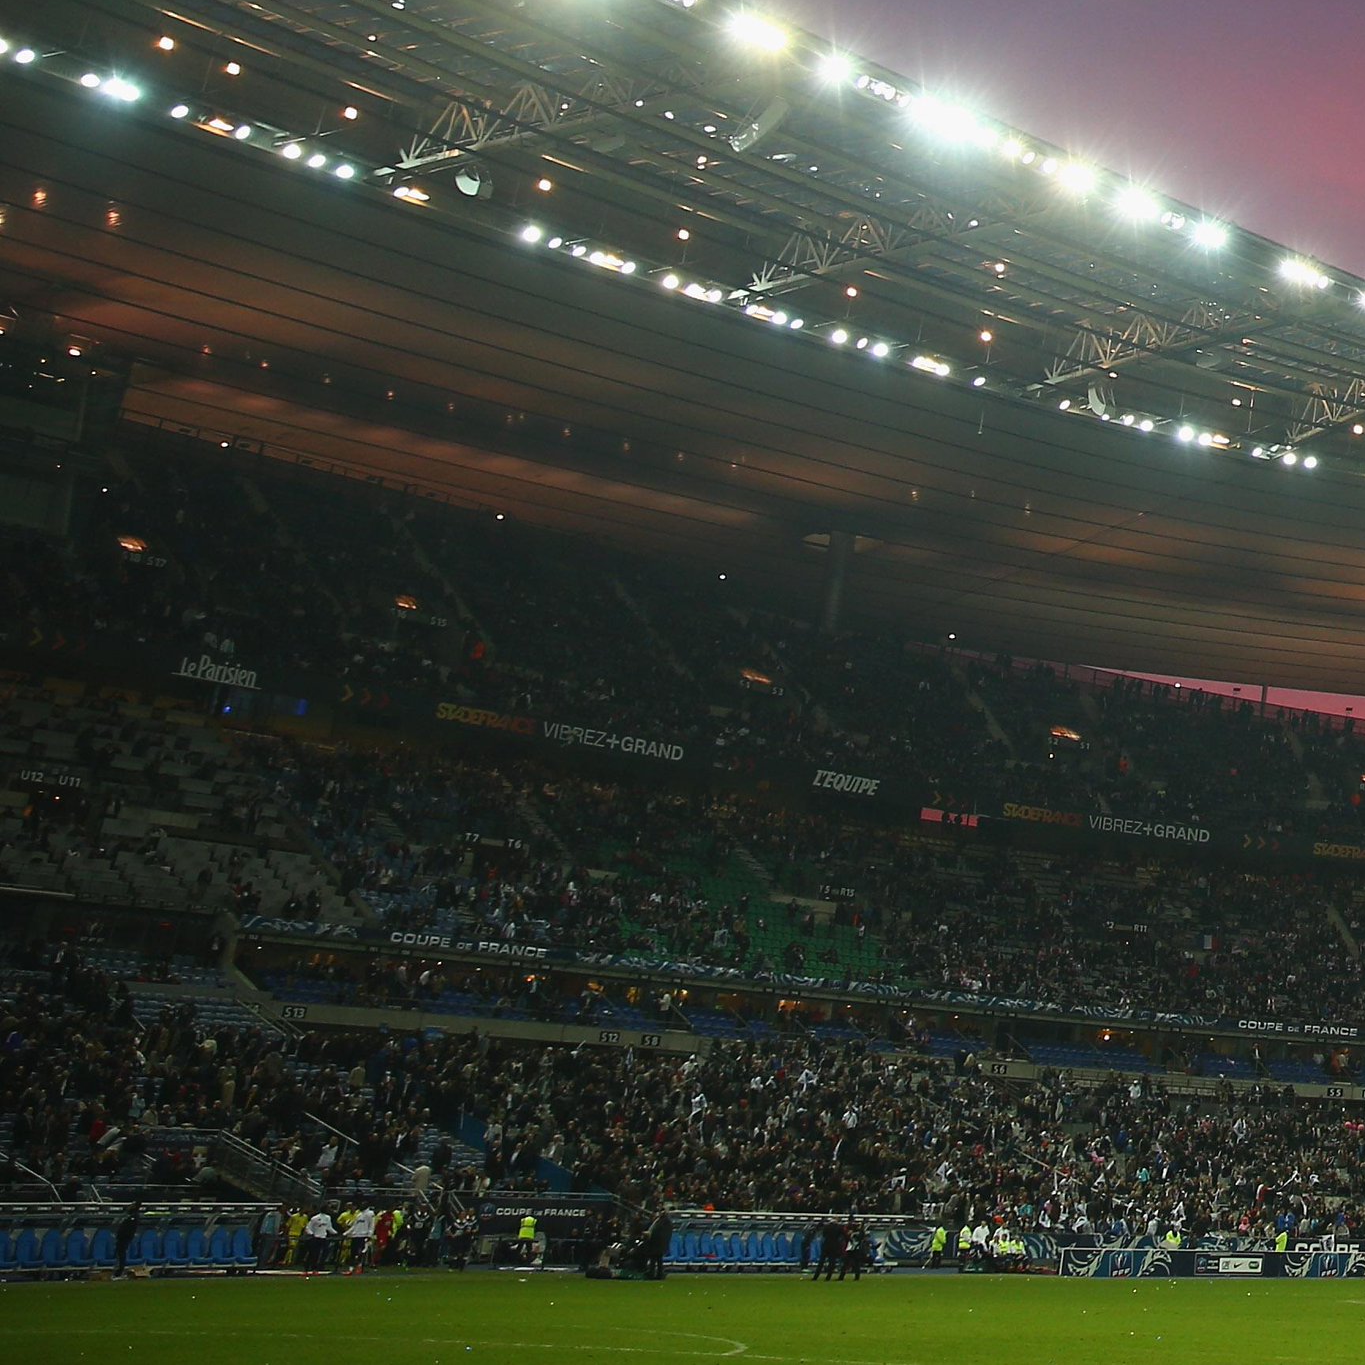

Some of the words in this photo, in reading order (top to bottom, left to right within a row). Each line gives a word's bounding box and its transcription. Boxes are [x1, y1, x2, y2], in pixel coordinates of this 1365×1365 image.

[21, 770, 44, 782] U12
[58, 775, 81, 788] U11
[390, 932, 450, 948] COUPE
[478, 941, 549, 959] FRANCE
[284, 1006, 305, 1018] S13
[1238, 1020, 1283, 1031] COUPE
[1304, 1024, 1358, 1036] FRANCE
[601, 1033, 618, 1043] S12
[644, 1035, 659, 1045] S8
[496, 1208, 532, 1217] COUPE
[544, 1209, 586, 1217] FRANCE
